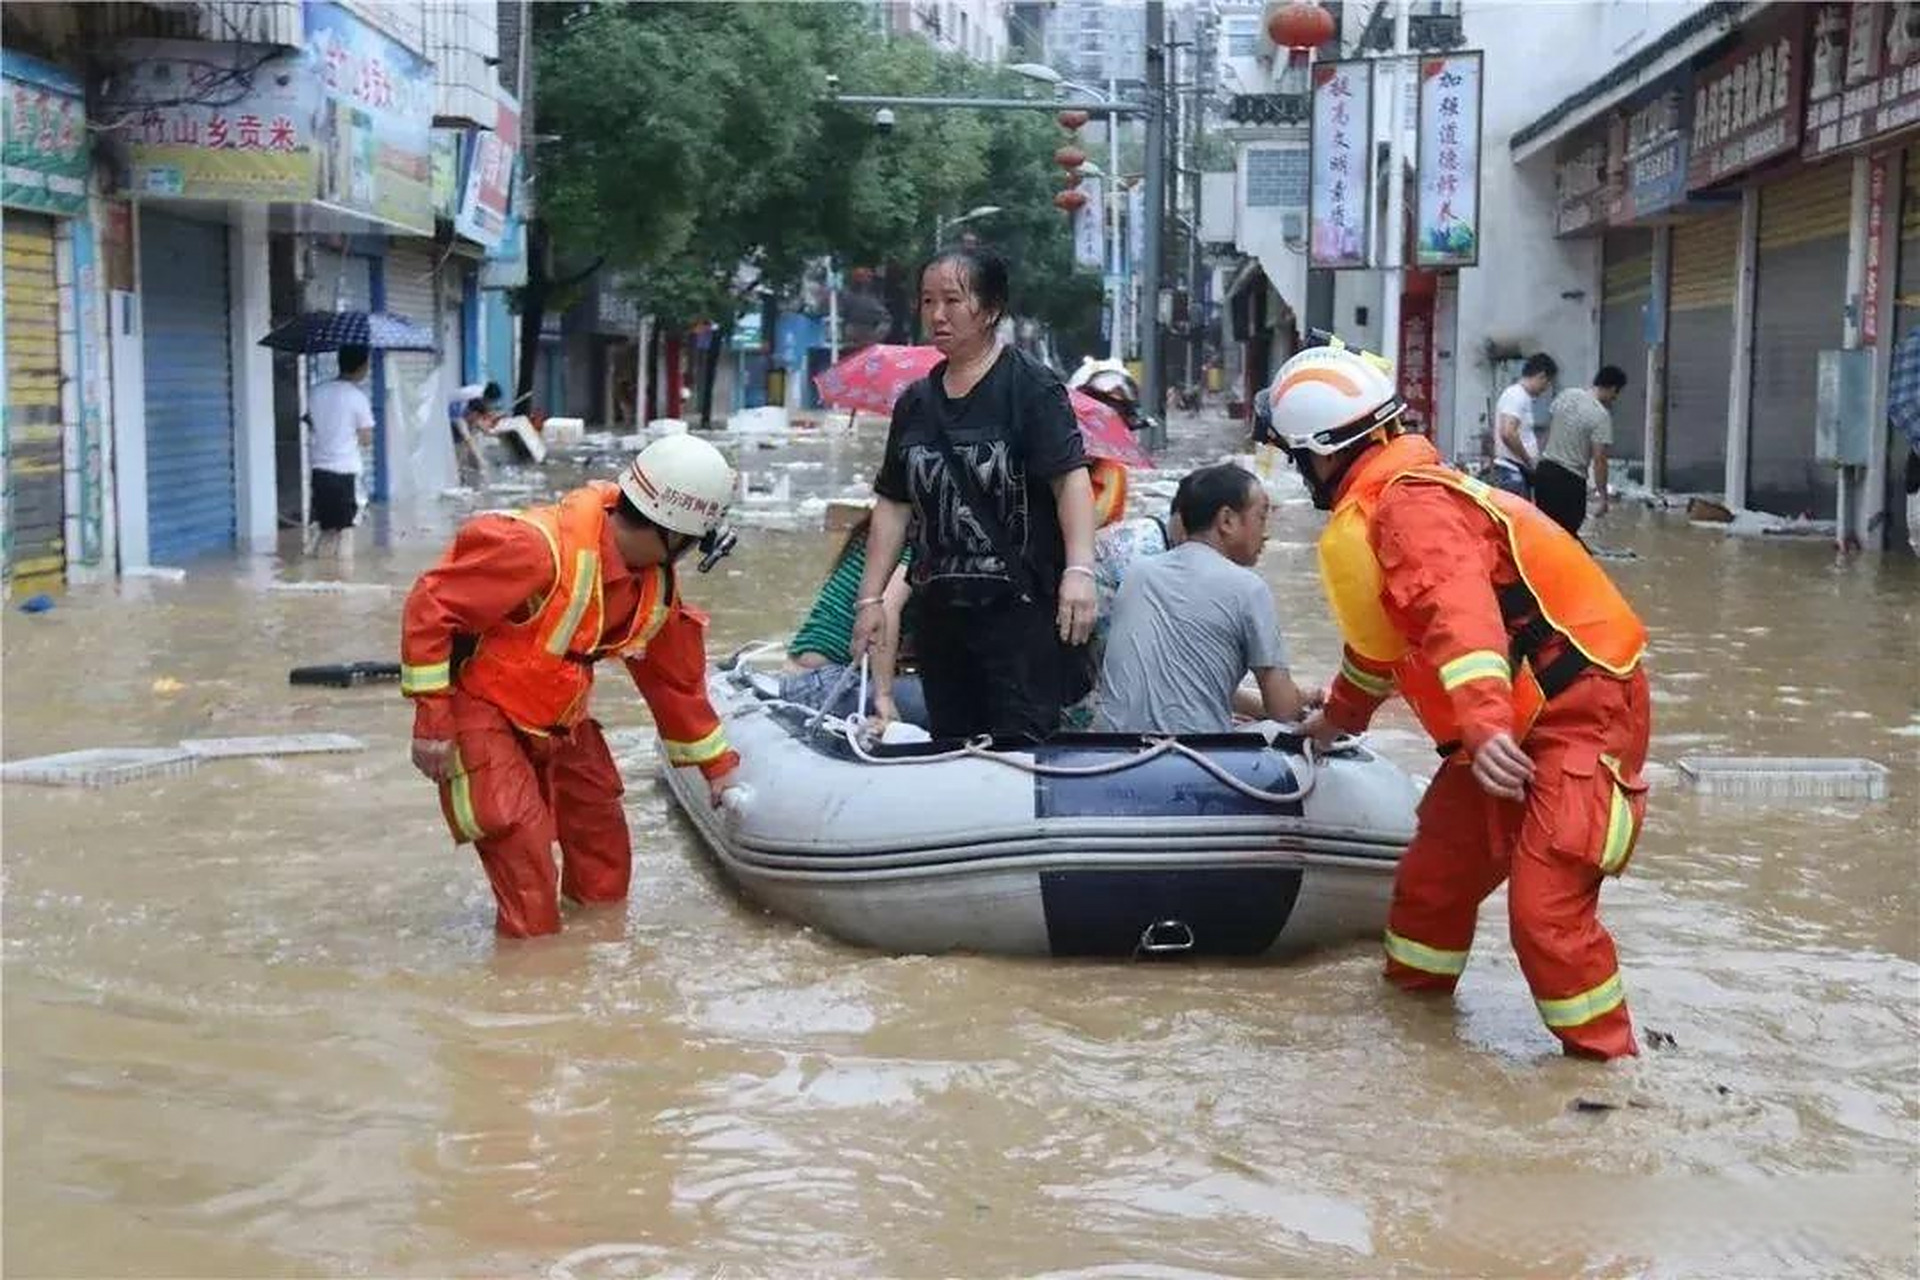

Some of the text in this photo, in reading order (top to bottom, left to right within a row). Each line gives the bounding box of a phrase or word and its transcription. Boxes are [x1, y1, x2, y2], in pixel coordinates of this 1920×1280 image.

[114, 110, 295, 152] 竹山乡贡米
